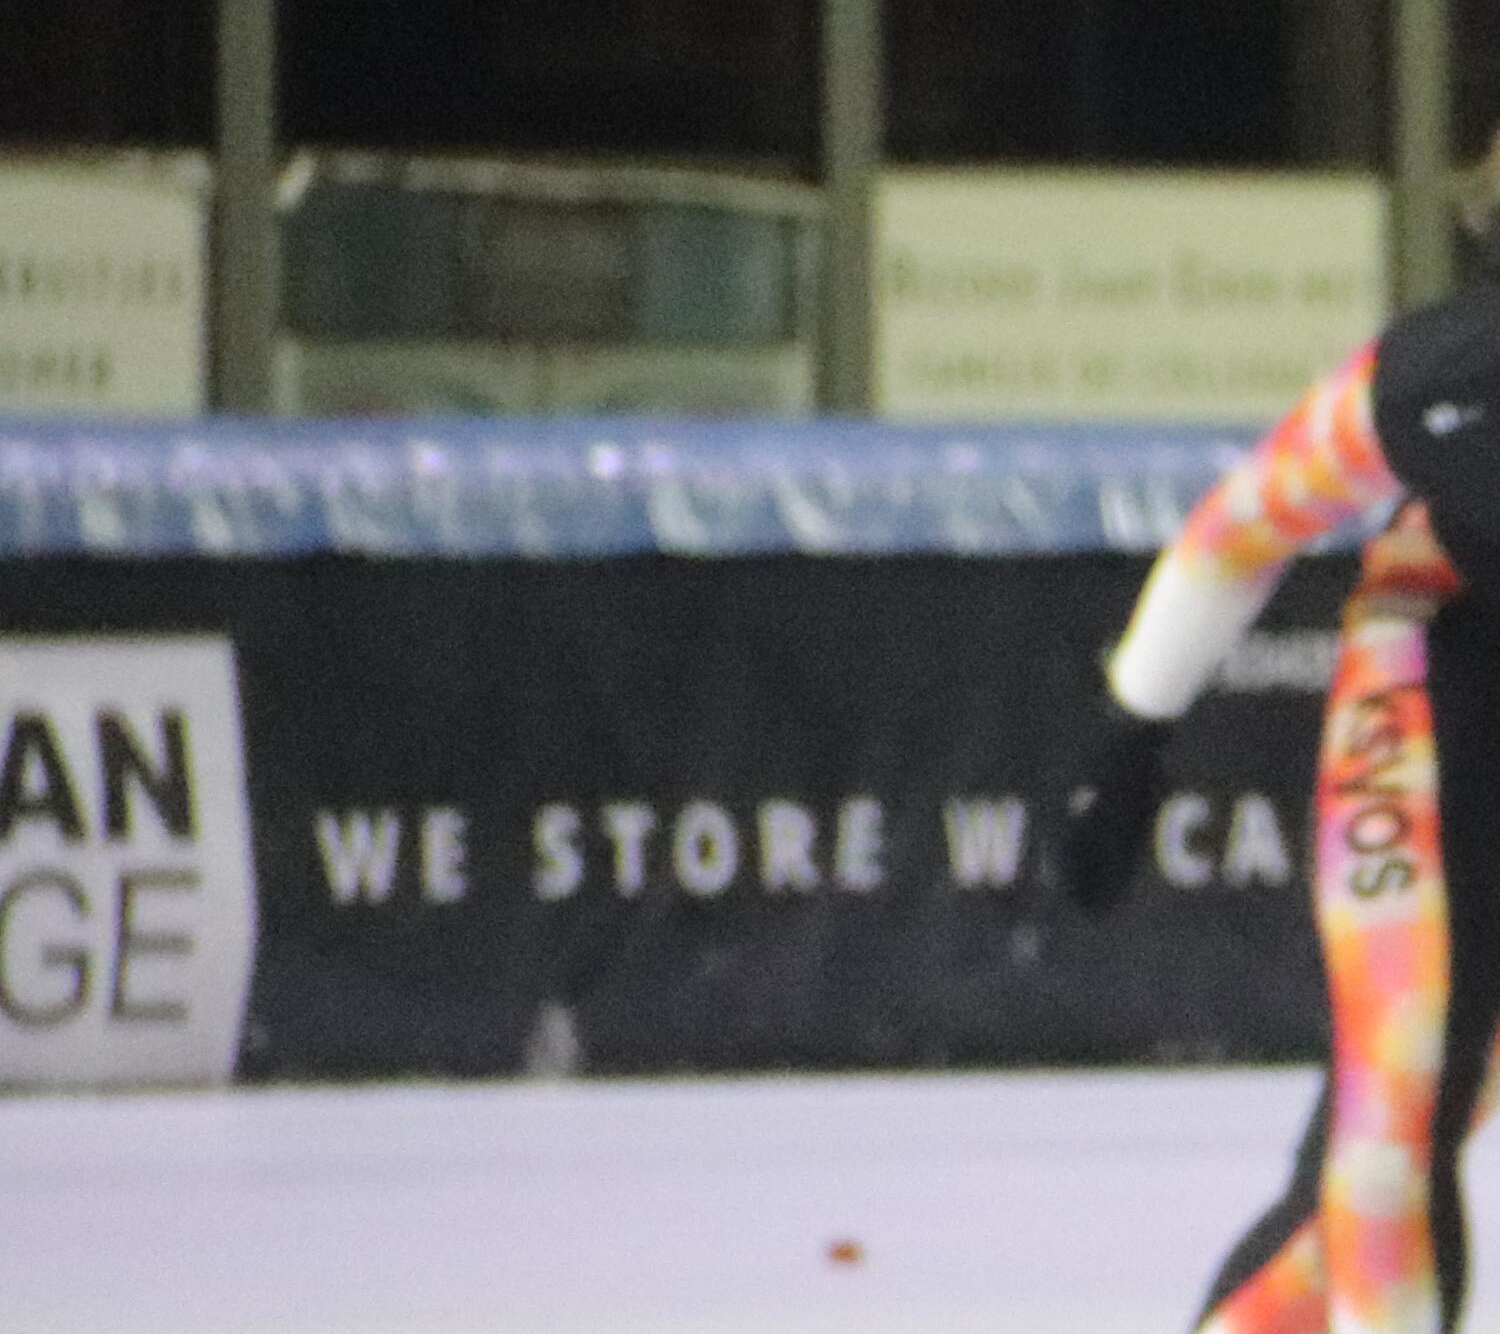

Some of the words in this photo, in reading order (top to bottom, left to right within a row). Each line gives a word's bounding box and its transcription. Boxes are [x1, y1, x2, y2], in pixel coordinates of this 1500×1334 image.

[313, 803, 470, 905] WE
[532, 795, 887, 900] STORE
[1152, 789, 1293, 891] CA
